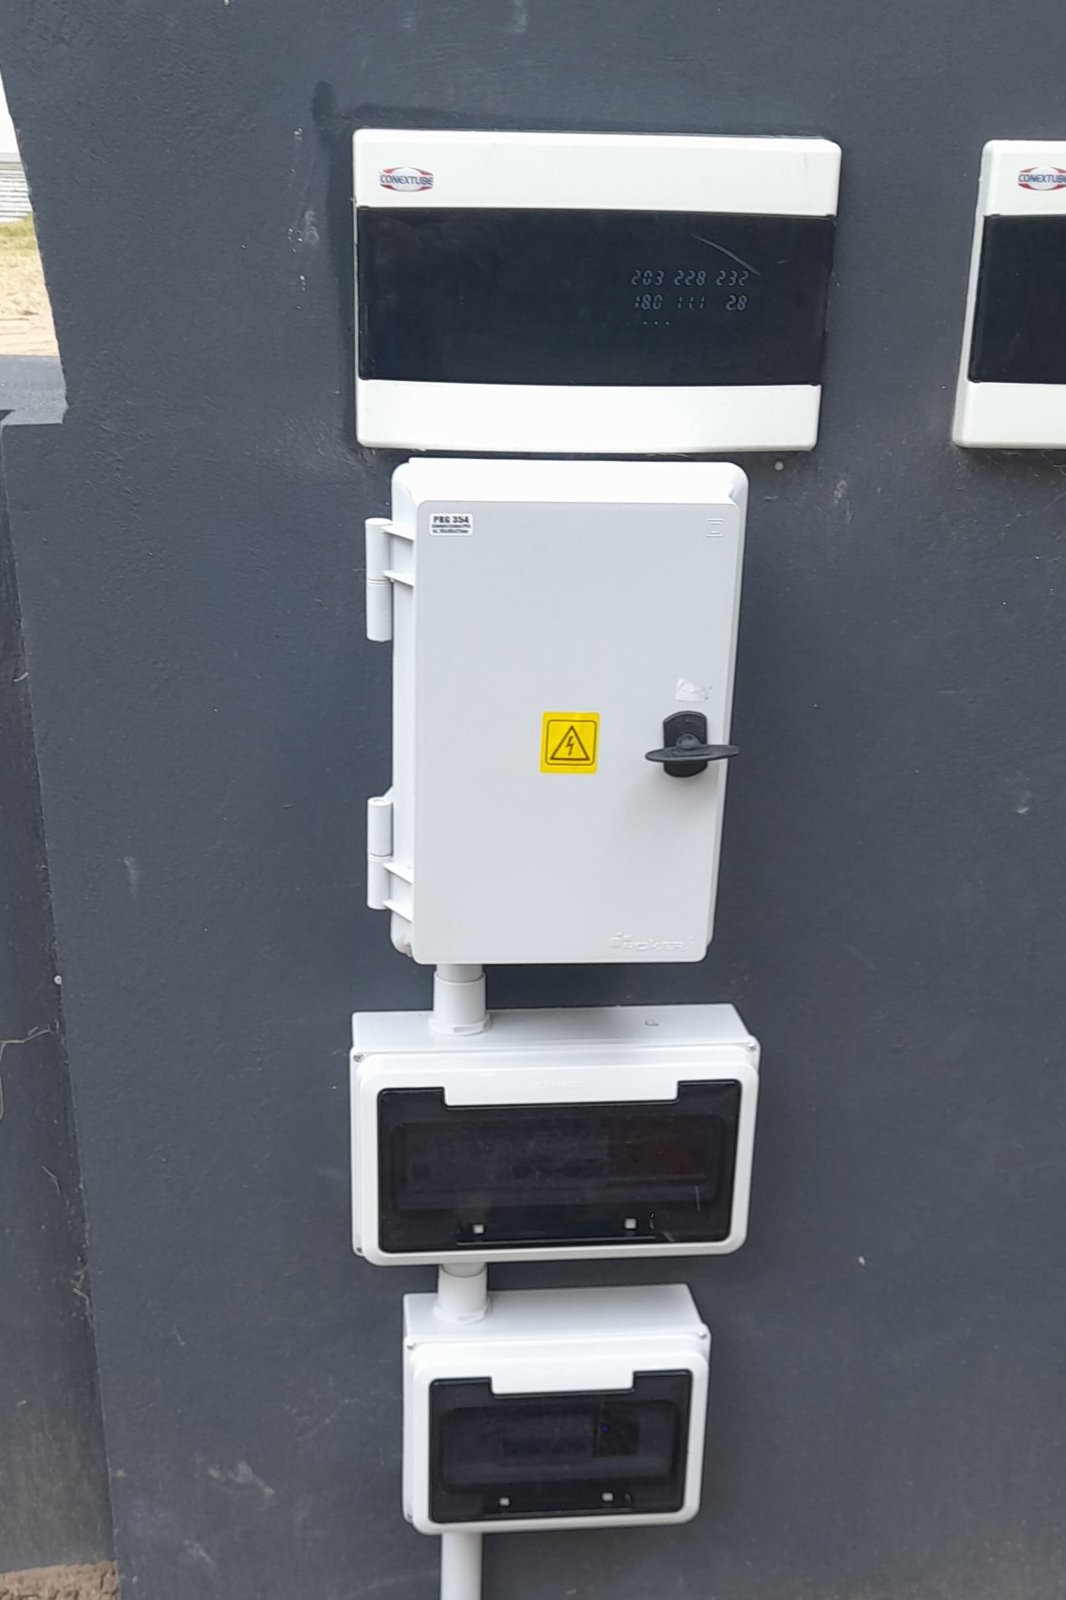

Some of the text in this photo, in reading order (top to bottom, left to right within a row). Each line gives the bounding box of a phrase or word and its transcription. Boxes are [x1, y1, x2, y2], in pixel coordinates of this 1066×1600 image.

[379, 174, 434, 186] CONEXTUBE
[630, 269, 750, 286] 203 228 232
